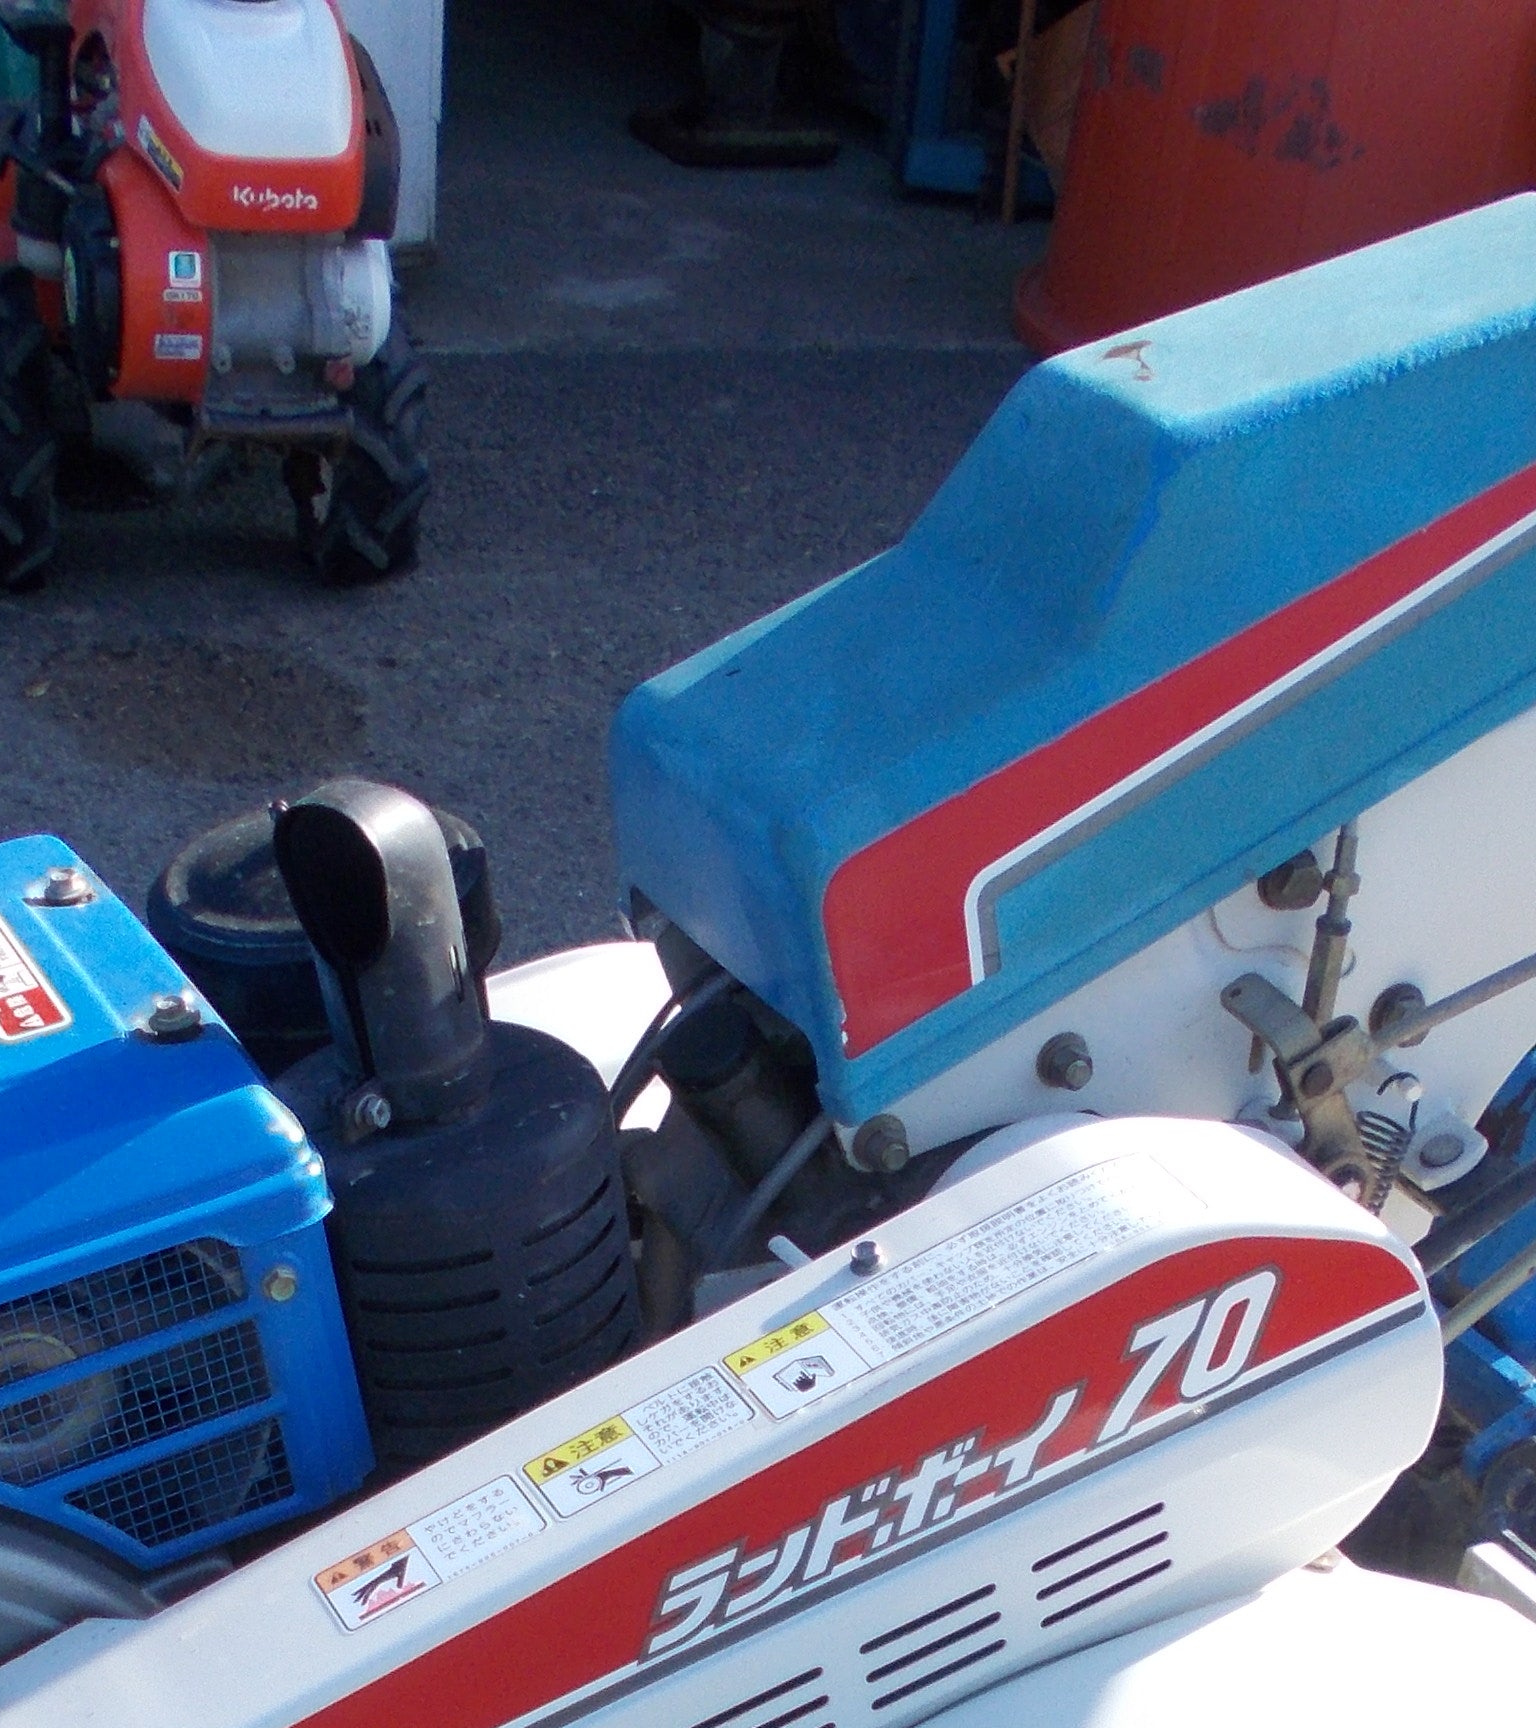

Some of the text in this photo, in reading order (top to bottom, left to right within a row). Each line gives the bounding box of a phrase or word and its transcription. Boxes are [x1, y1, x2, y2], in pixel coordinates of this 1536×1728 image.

[232, 186, 318, 212] Kubota
[764, 1322, 814, 1354] 注意
[569, 1424, 624, 1460] 注意
[647, 1270, 1276, 1654] ランドボーイ 70
